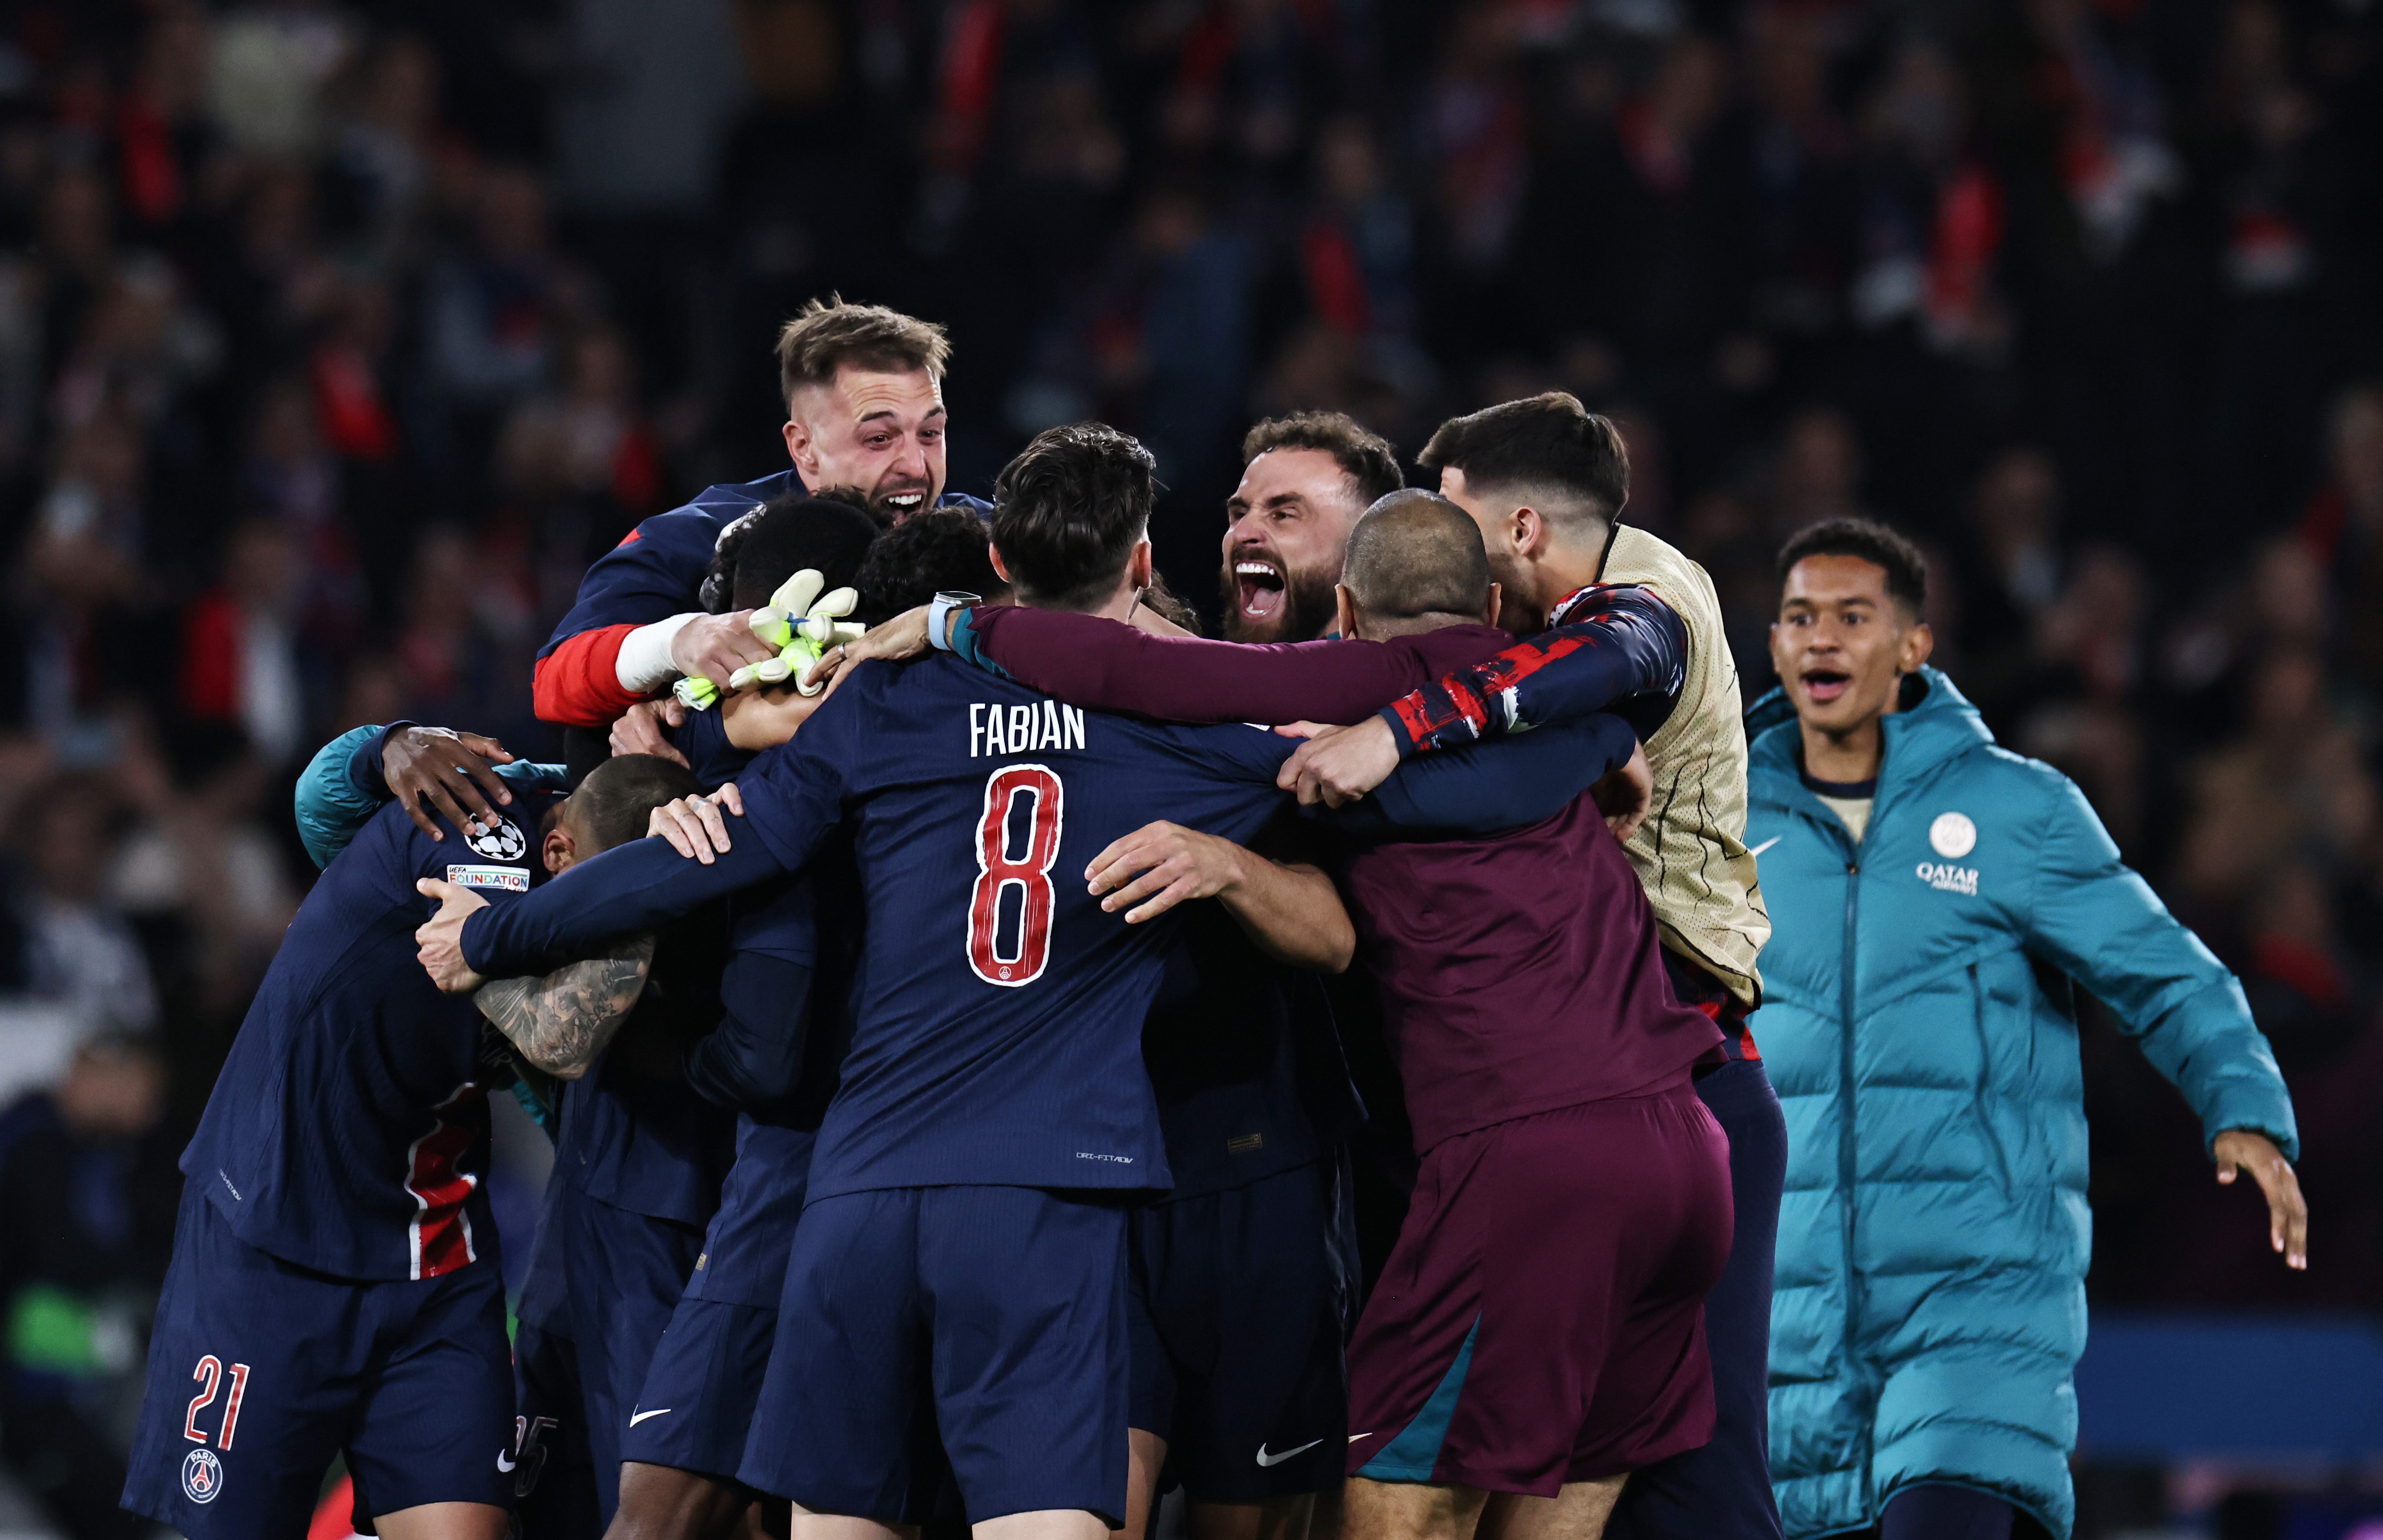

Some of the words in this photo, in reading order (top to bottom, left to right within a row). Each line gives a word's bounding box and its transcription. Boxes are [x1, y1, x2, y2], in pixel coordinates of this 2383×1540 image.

[970, 700, 1085, 757] FABIAN
[966, 763, 1064, 987] 8
[1915, 862, 1979, 885] QATAR
[184, 1354, 250, 1451] 21
[190, 1451, 218, 1468] PARIS
